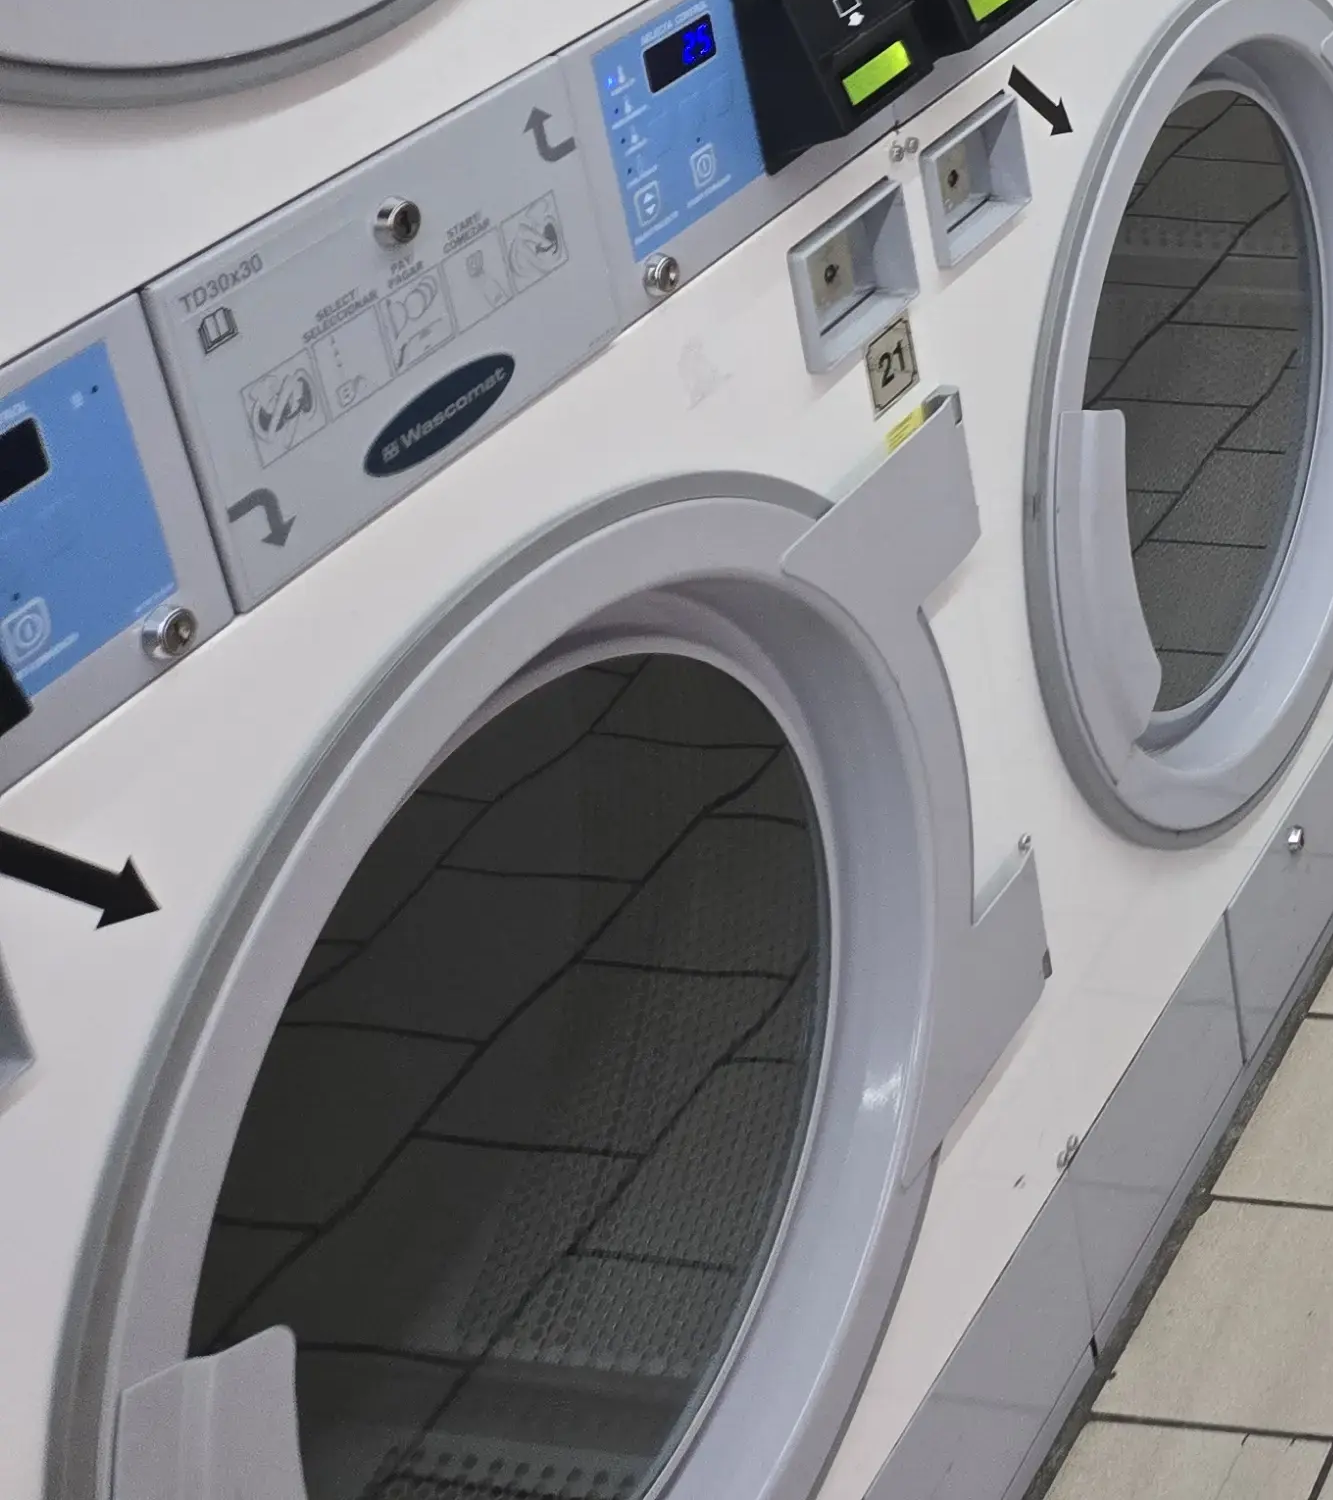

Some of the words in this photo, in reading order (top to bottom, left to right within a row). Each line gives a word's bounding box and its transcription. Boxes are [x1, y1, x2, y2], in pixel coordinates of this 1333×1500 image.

[681, 22, 712, 65] 25
[178, 252, 264, 313] TD30x30
[387, 260, 424, 289] PAGAR
[302, 288, 380, 344] SELECCIONAR
[877, 339, 905, 389] 21
[400, 366, 507, 449] Wascomat
